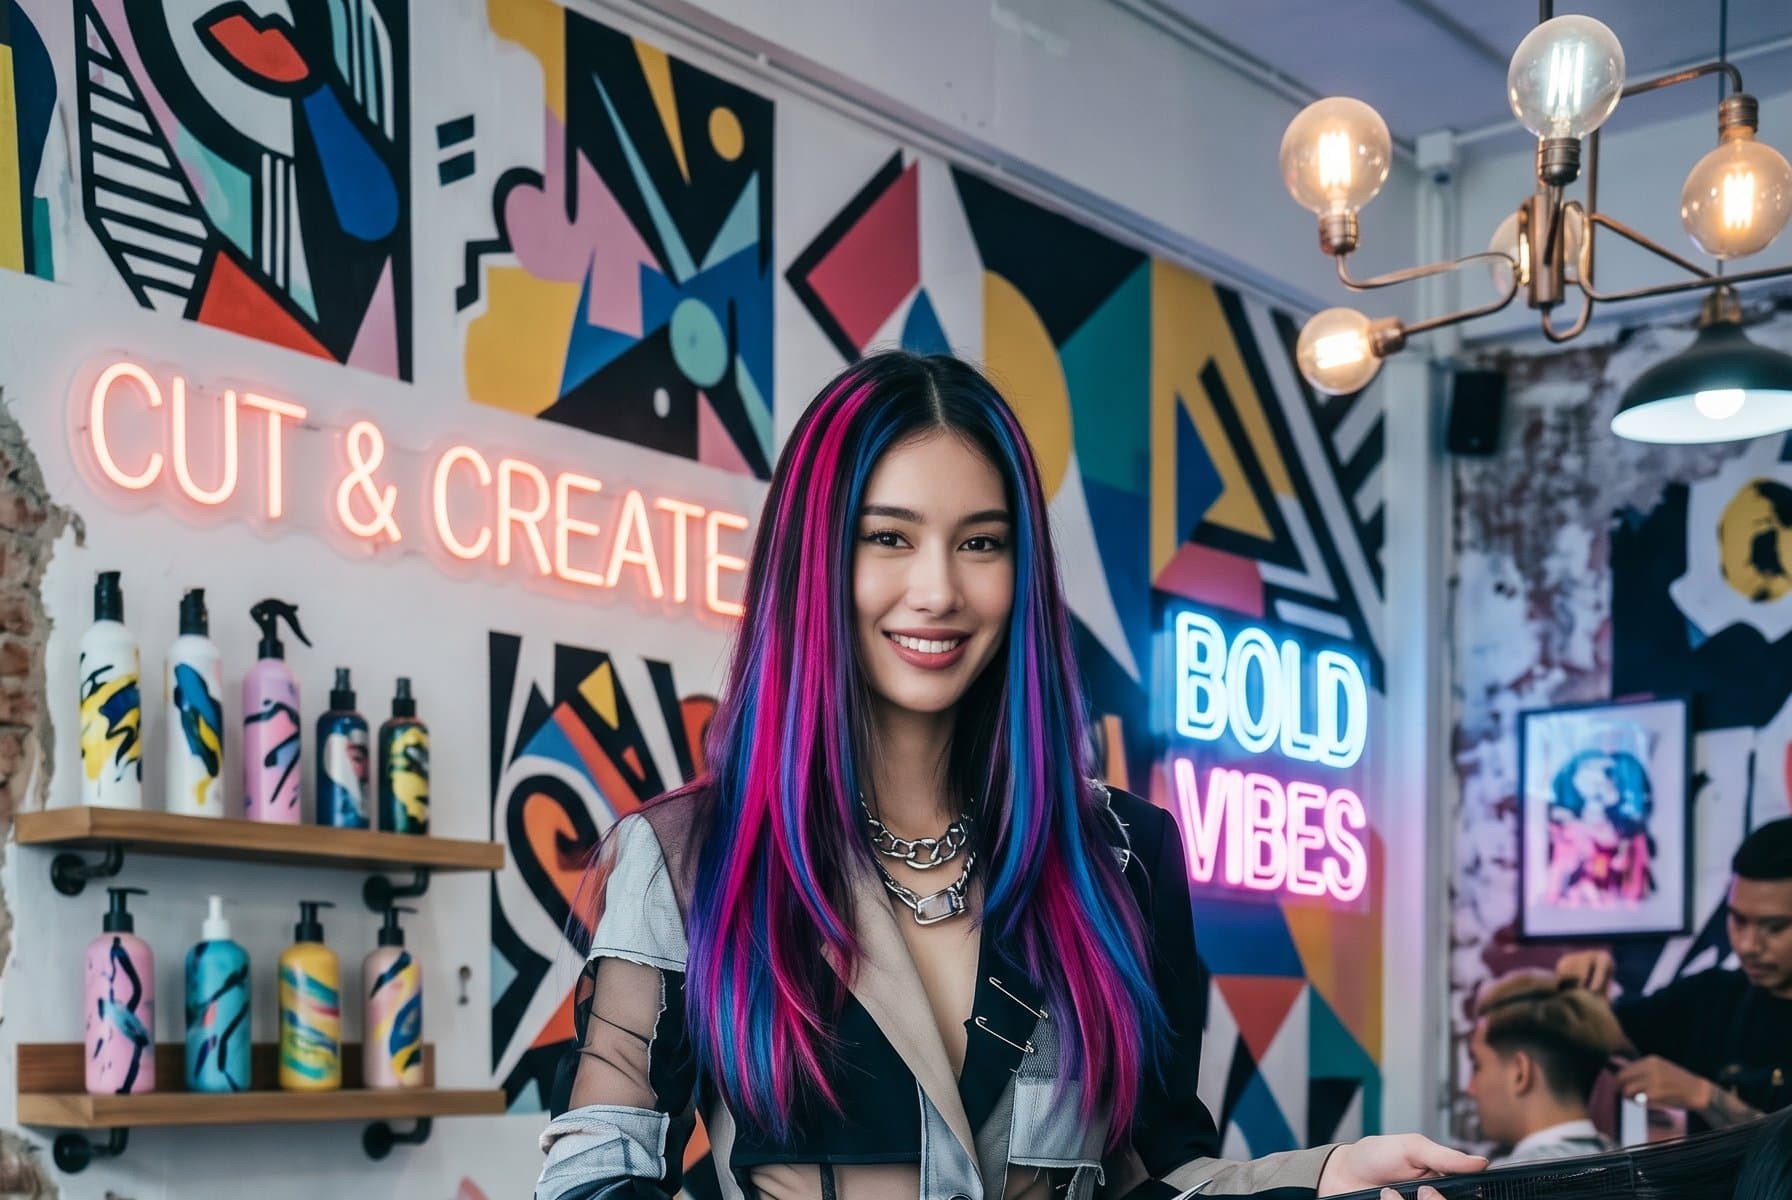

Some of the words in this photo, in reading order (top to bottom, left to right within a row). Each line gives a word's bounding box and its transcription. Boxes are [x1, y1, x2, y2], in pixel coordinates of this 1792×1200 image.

[90, 362, 307, 518] CUT
[337, 421, 402, 542] &
[434, 445, 750, 616] CREATE
[1176, 611, 1367, 768] BOLD
[1175, 758, 1367, 901] VIBES
